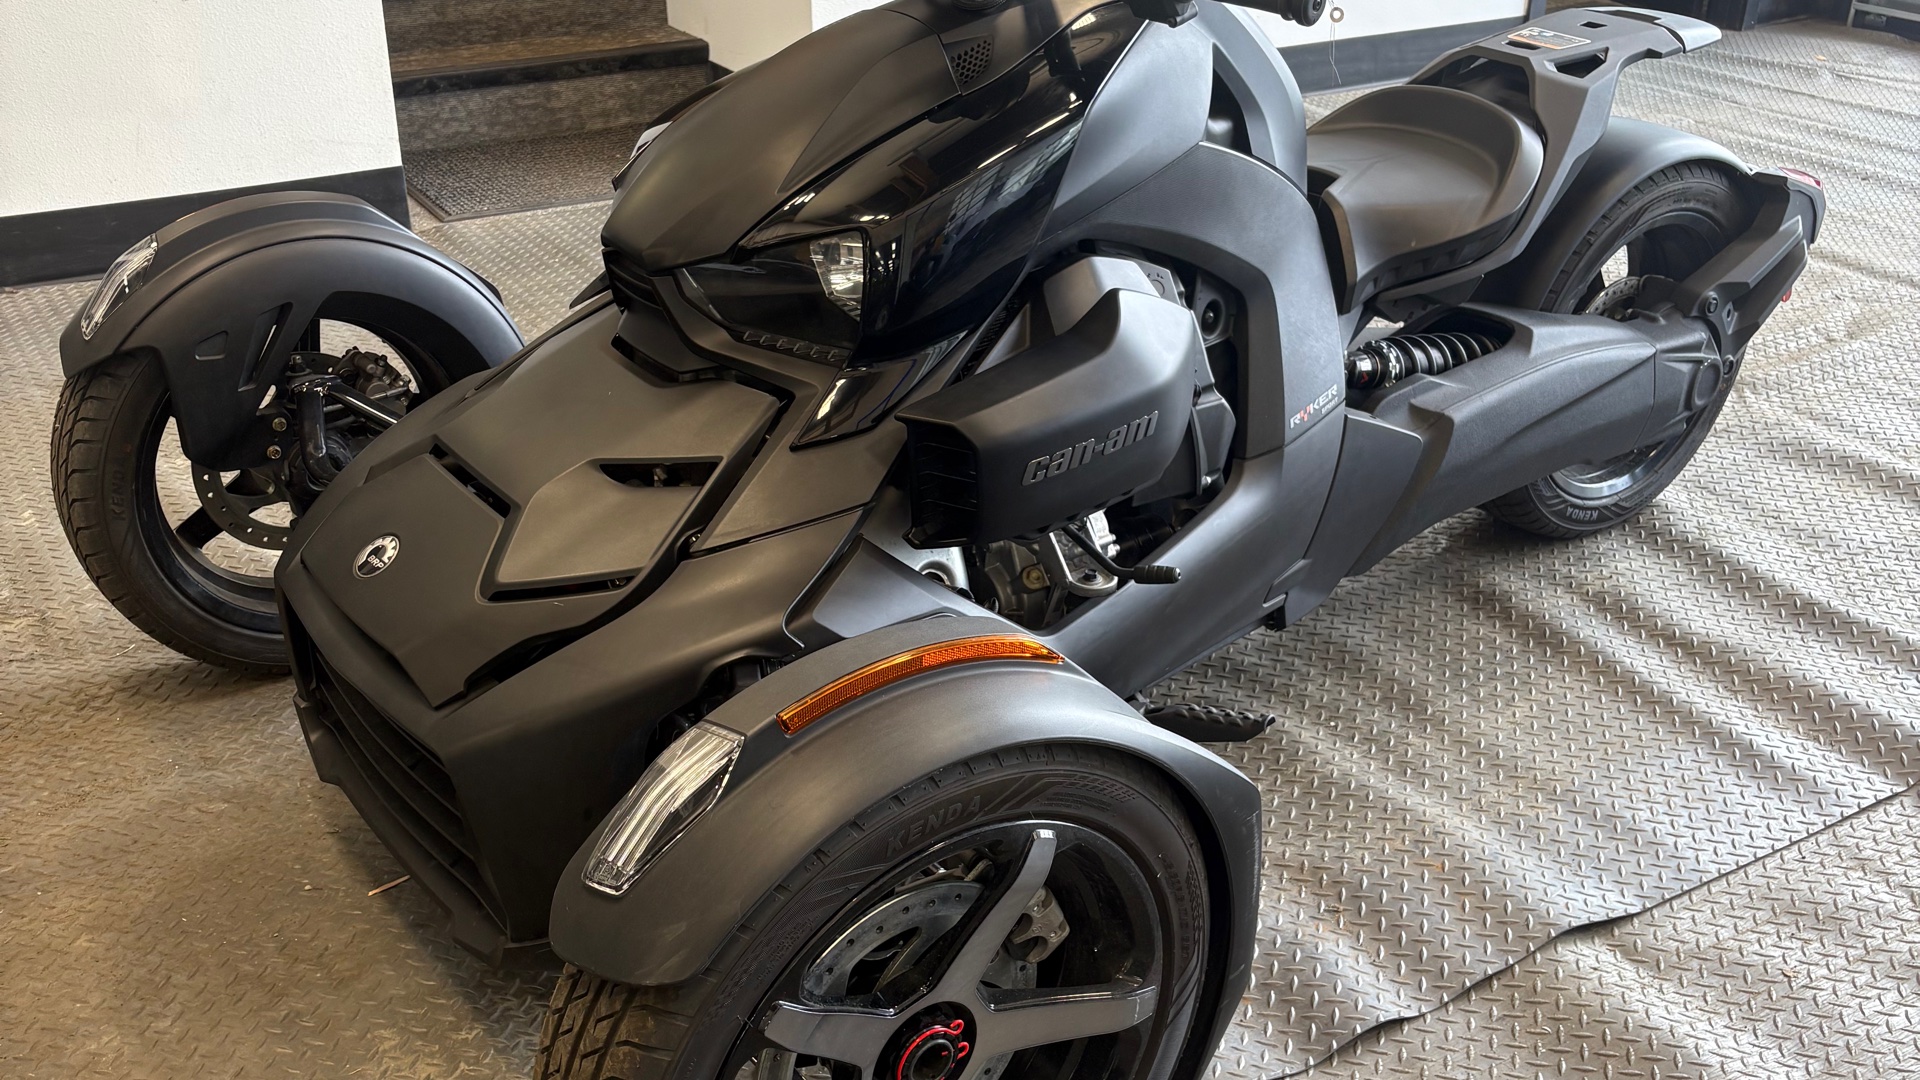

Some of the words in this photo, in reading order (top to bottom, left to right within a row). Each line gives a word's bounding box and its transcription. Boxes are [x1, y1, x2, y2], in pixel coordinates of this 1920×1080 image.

[1290, 384, 1338, 429] RYKER
[1021, 410, 1159, 487] can-am
[1566, 505, 1599, 521] KENDA
[367, 554, 385, 569] BRP
[886, 795, 981, 859] KENDA
